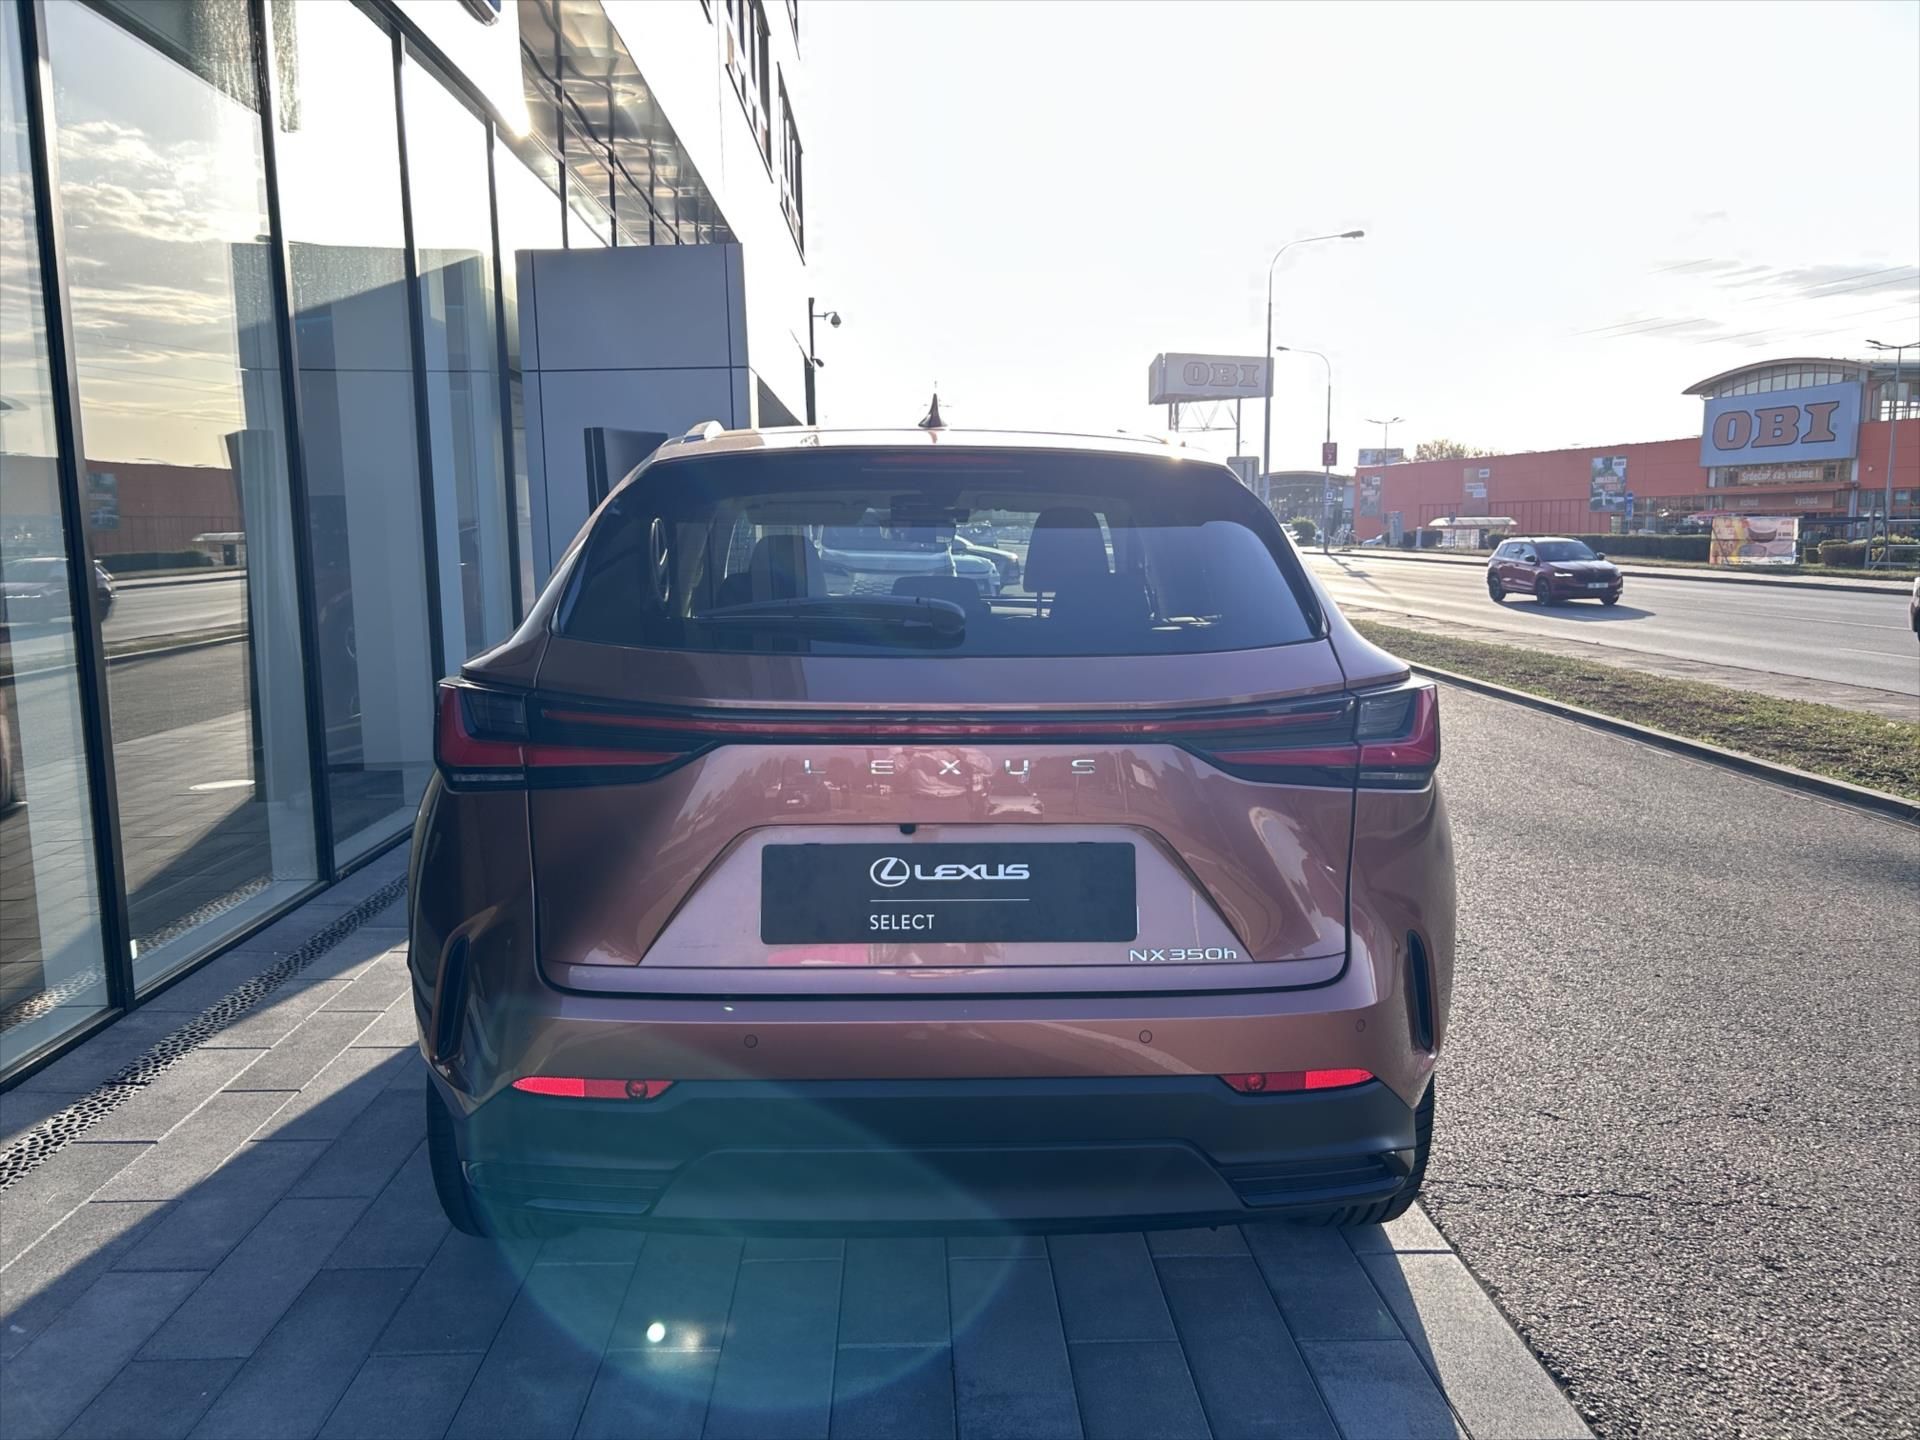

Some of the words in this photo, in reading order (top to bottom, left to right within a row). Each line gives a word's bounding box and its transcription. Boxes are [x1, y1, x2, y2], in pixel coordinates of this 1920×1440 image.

[1183, 361, 1260, 388] OBI
[1712, 401, 1840, 451] OBI
[803, 758, 1097, 776] LEXUS
[914, 863, 1030, 881] LEXUS
[869, 913, 935, 931] SELECT
